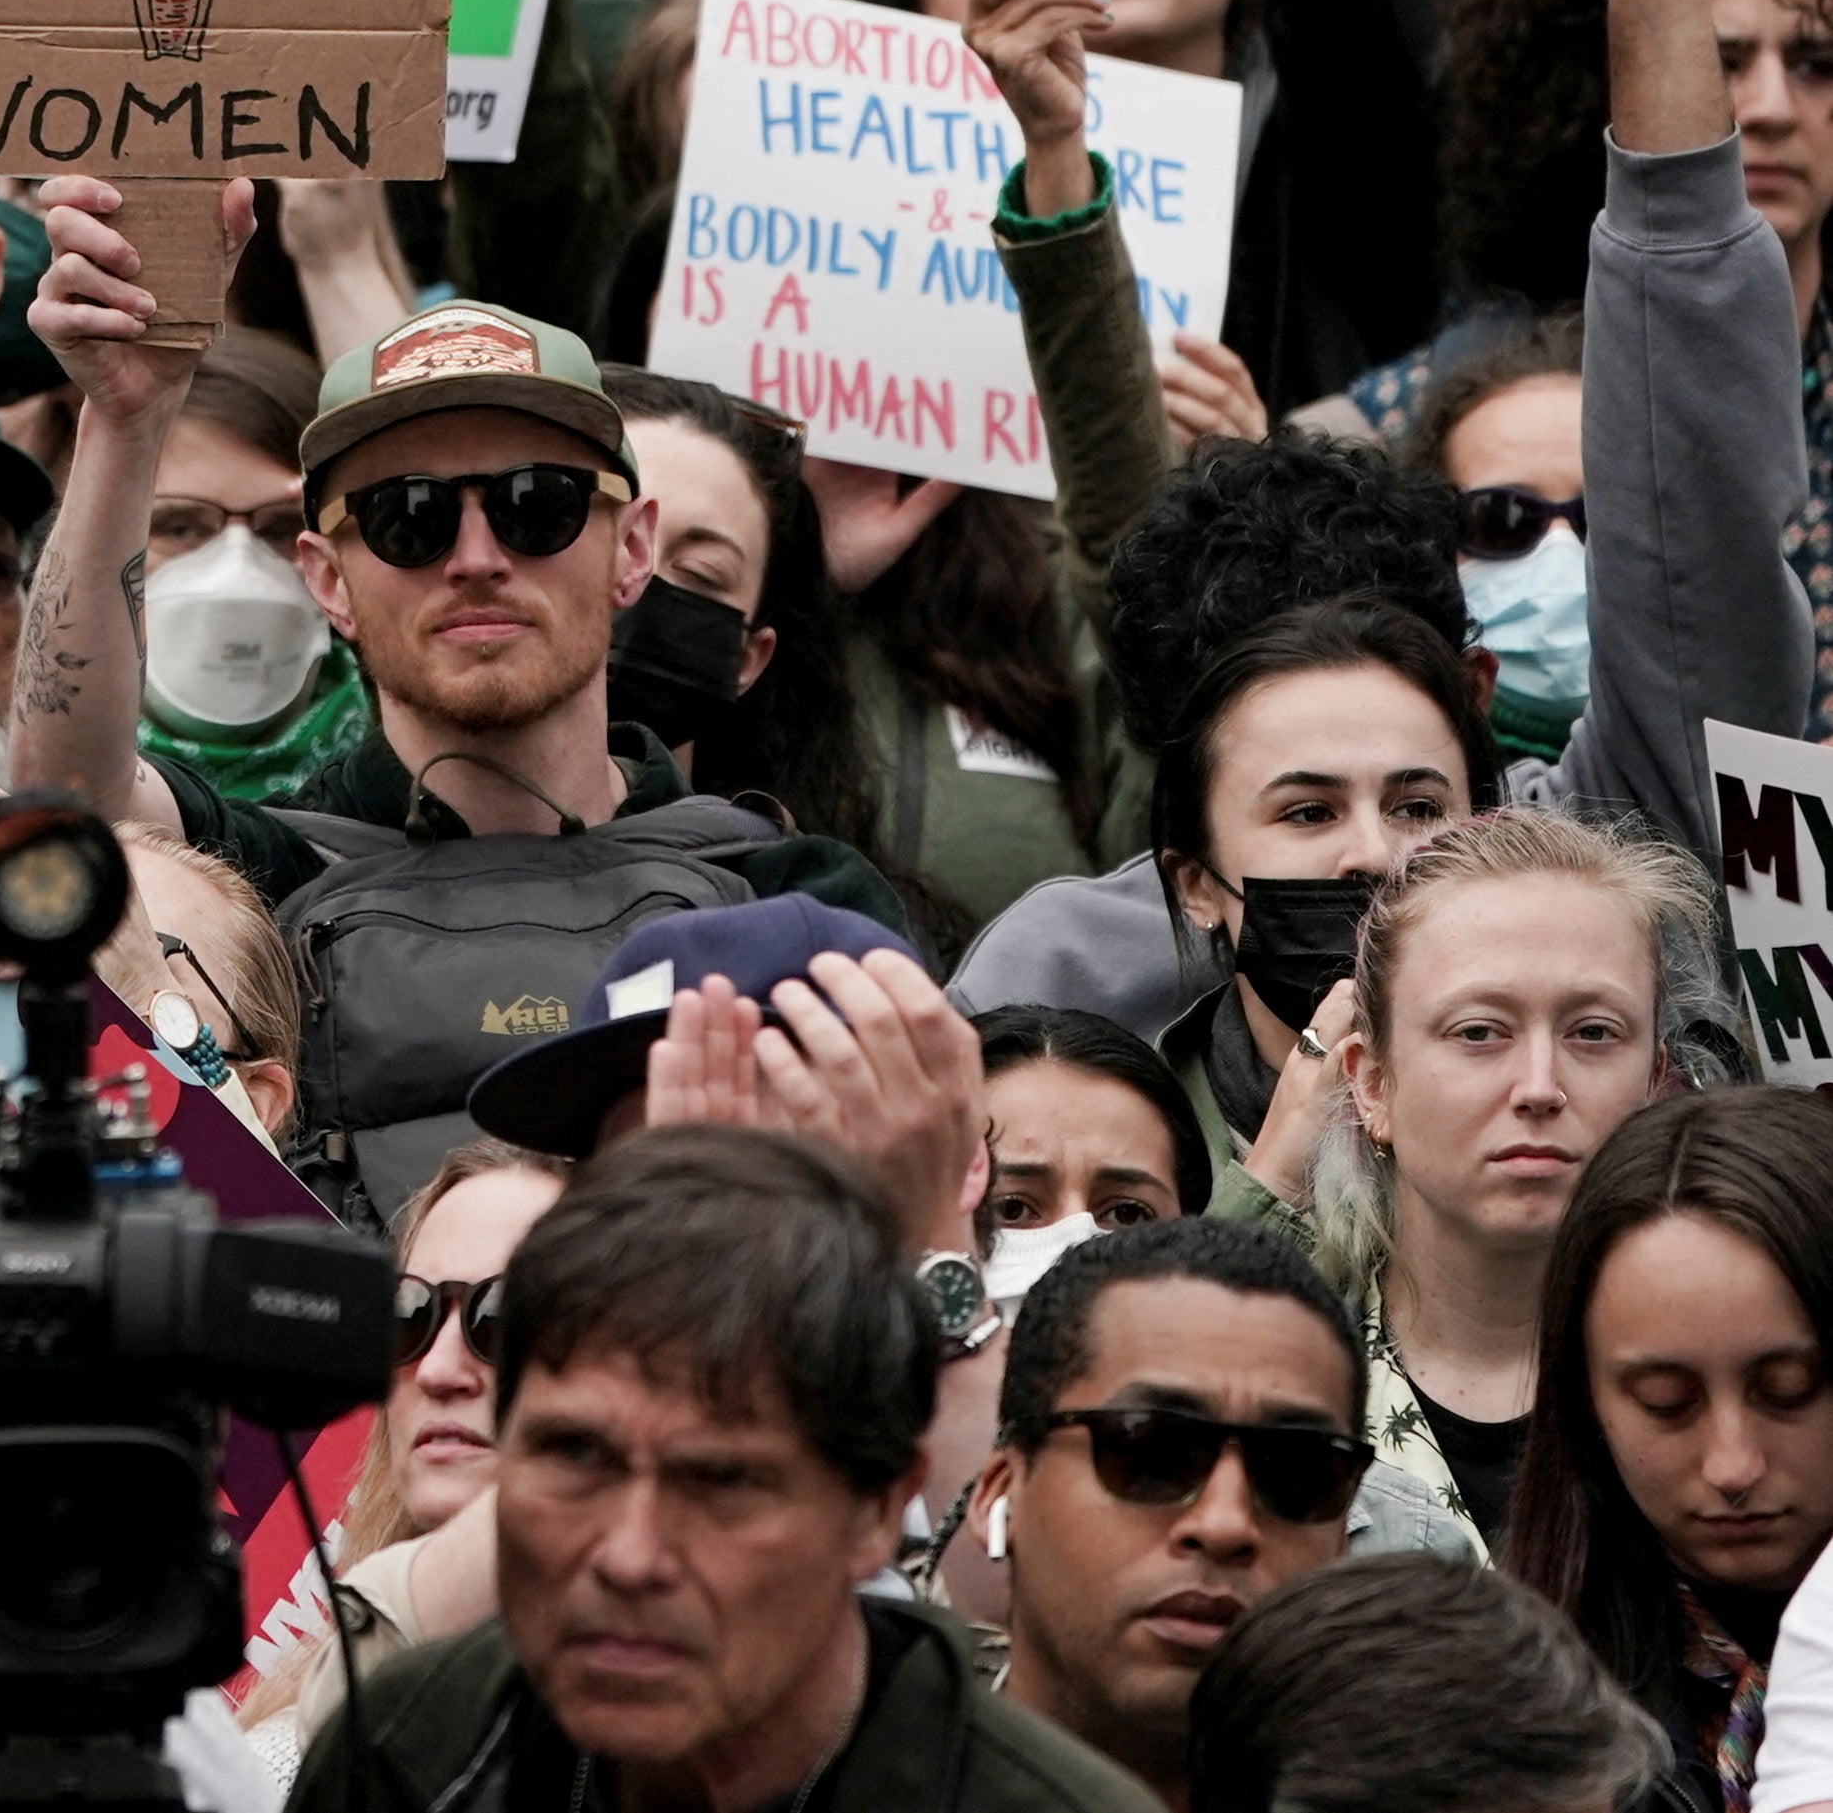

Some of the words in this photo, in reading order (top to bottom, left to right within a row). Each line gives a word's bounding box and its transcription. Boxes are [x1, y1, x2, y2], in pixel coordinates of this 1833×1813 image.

[721, 0, 1004, 103] ABORTION
[688, 193, 898, 291] BODILY
[682, 265, 725, 326] IS
[762, 272, 810, 333] A
[750, 341, 955, 451] HUMAN
[512, 1005, 569, 1026] REI
